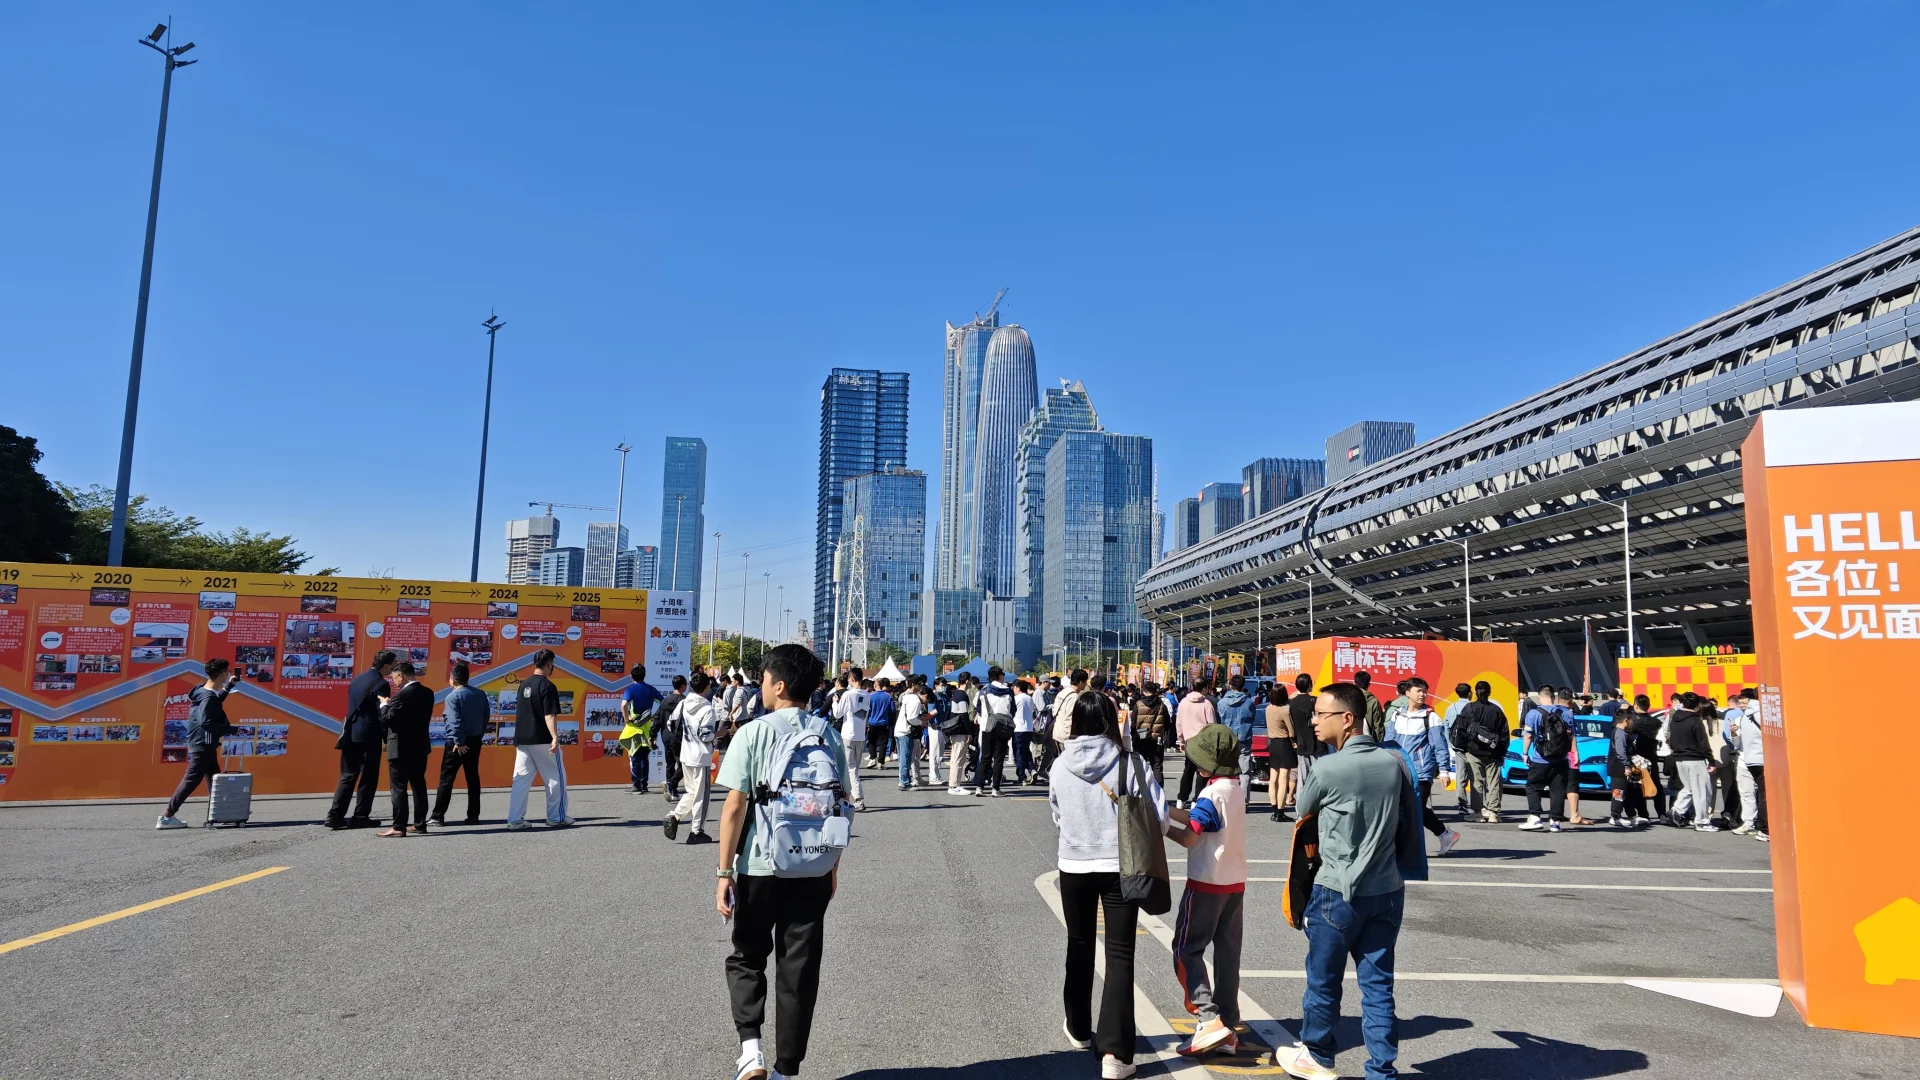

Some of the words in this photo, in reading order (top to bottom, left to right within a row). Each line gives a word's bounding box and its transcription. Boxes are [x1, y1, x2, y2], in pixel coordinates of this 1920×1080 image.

[0, 569, 19, 580] 19
[93, 572, 133, 584] 2020
[203, 577, 237, 588] 2021
[304, 581, 338, 592] 2022
[399, 585, 432, 596] 2023
[489, 588, 519, 600] 2024
[572, 592, 601, 603] 2025
[660, 598, 684, 607] 十周年
[655, 607, 688, 616] 感恩陪伴
[1791, 603, 1920, 640] 又见面
[662, 629, 691, 639] 大家车
[1334, 647, 1417, 670] 情怀车展
[804, 845, 830, 854] YONEX
